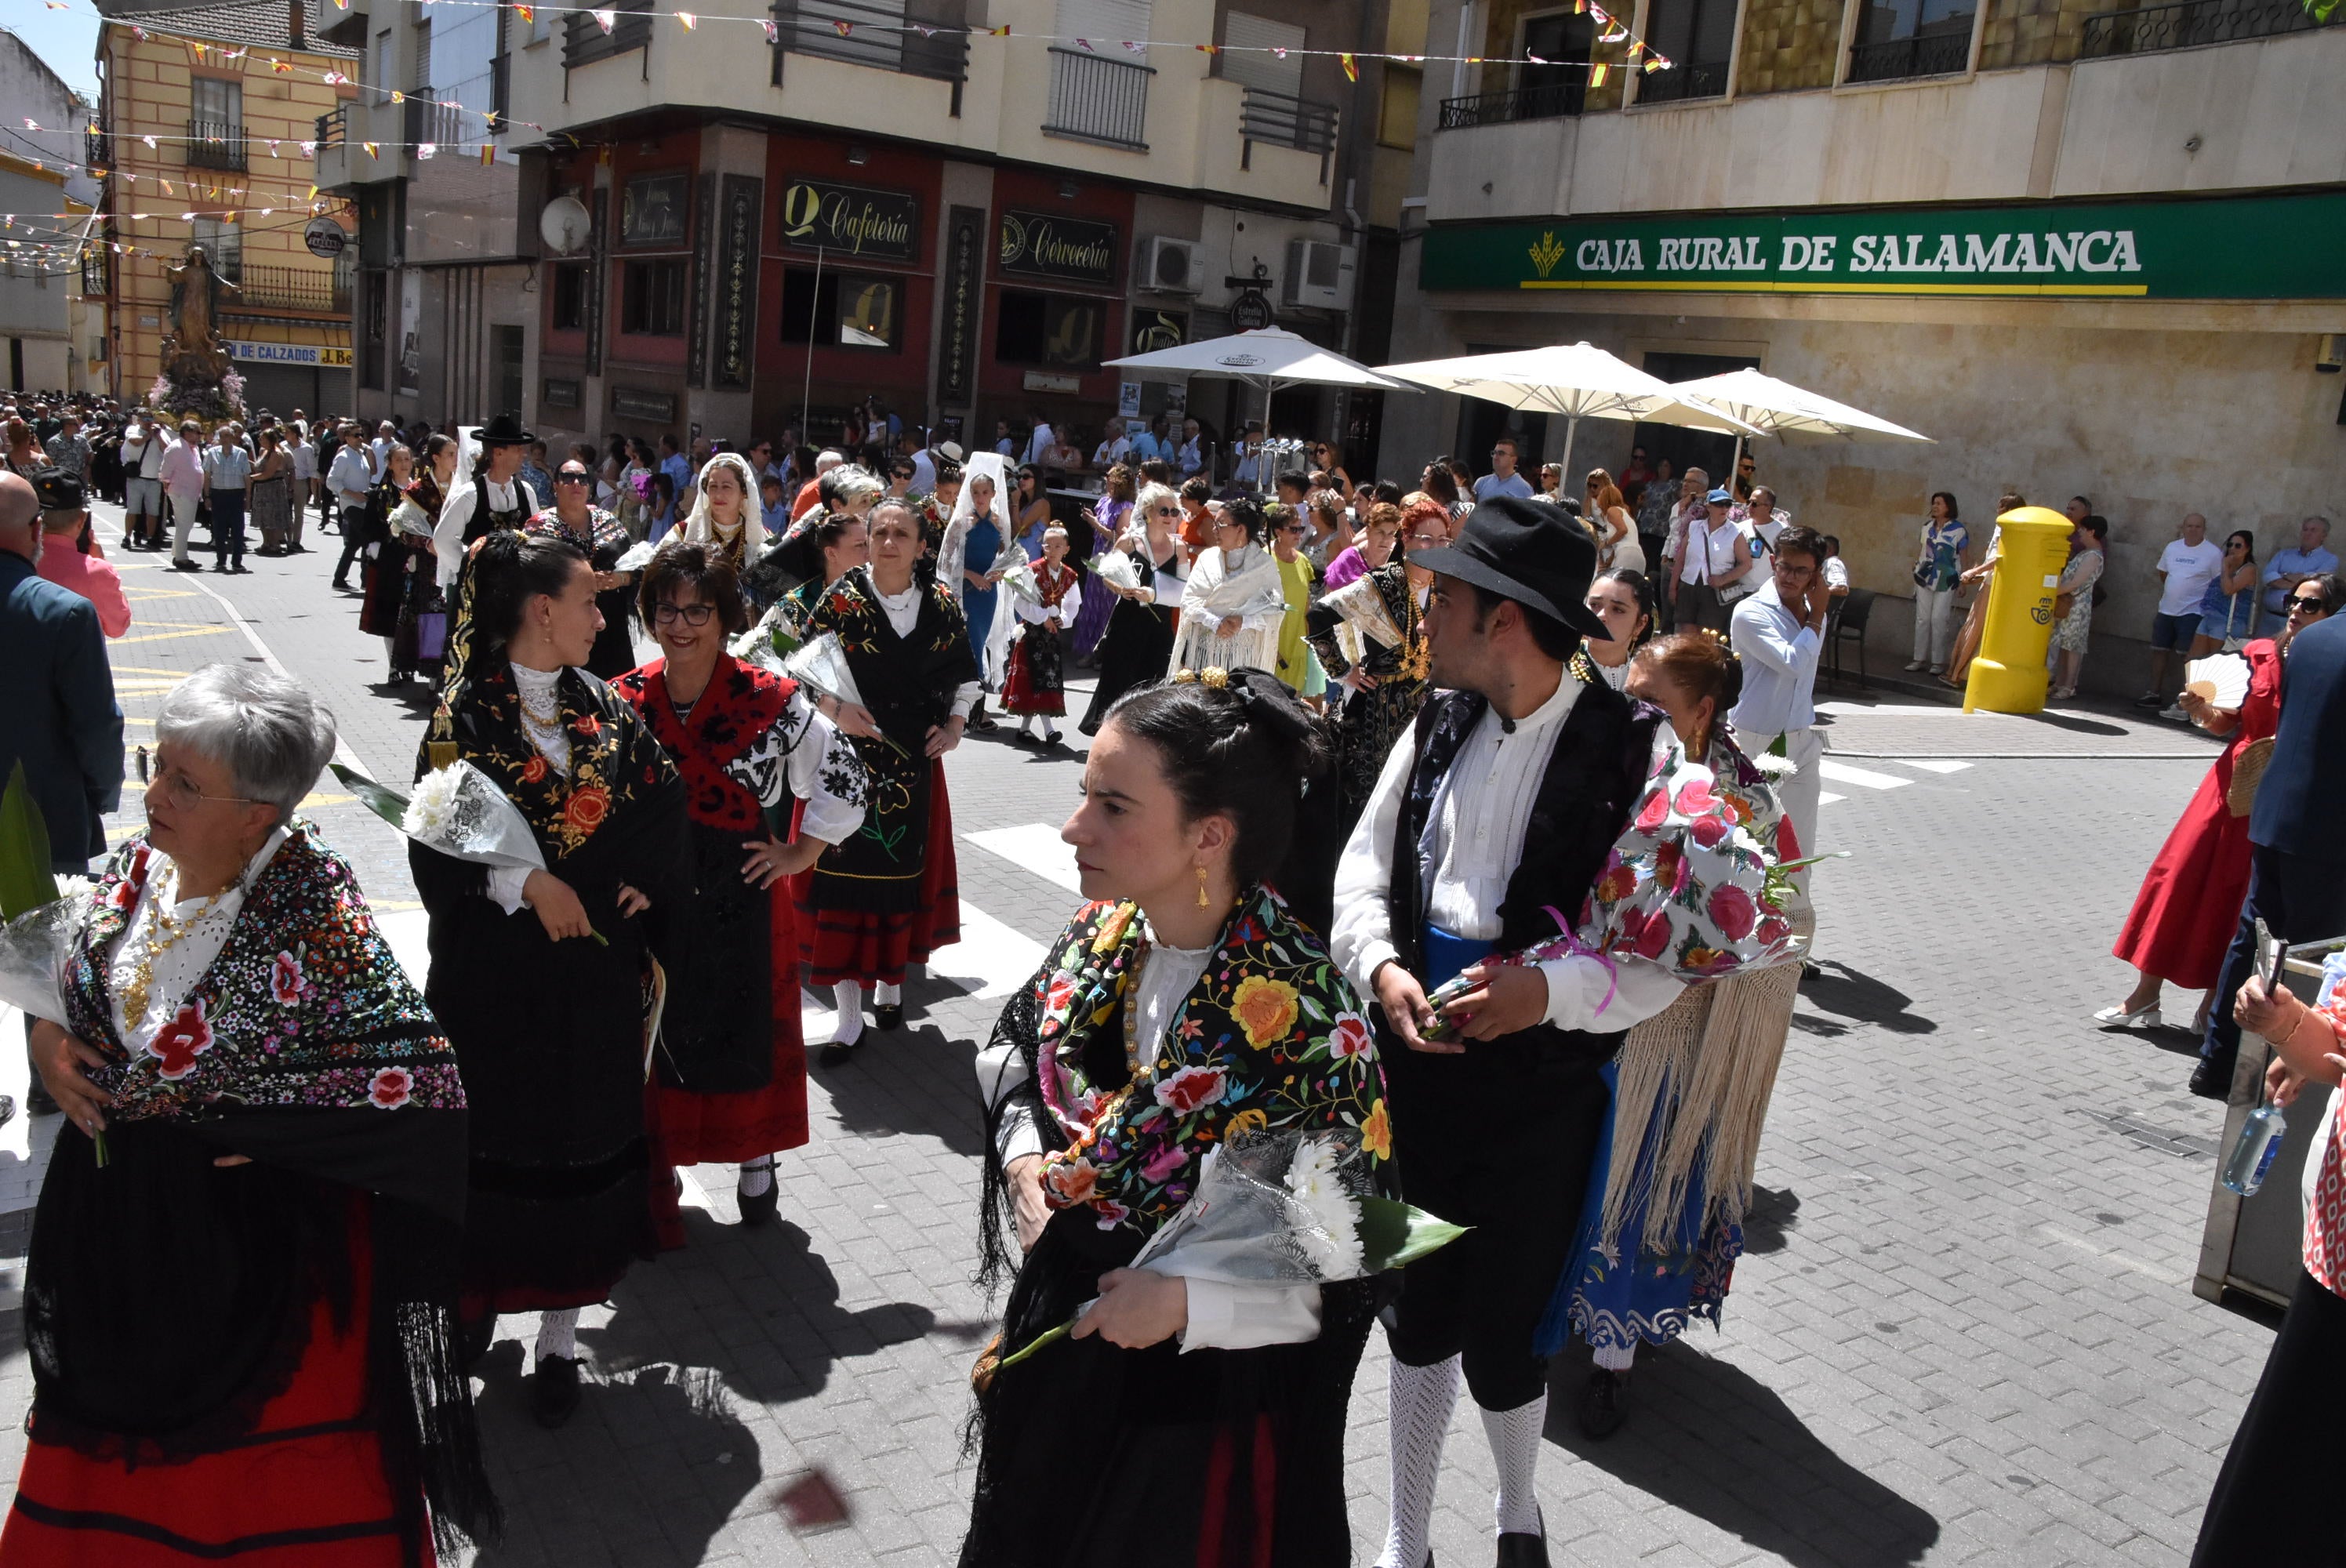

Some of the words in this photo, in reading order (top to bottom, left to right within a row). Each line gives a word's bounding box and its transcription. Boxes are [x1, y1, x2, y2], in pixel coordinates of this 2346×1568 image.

[821, 192, 909, 254] Cafetería
[1026, 218, 1109, 271] Cervecería
[1575, 238, 1645, 274] CAJA
[1656, 236, 1767, 271] RURAL
[1778, 236, 1837, 271] DE
[1849, 230, 2142, 273] SALAMANCA
[1237, 306, 1262, 317] Estrella
[1237, 315, 1261, 326] Galicia
[241, 345, 253, 358] DE
[258, 346, 316, 362] CALZADOS
[322, 349, 333, 364] J.
